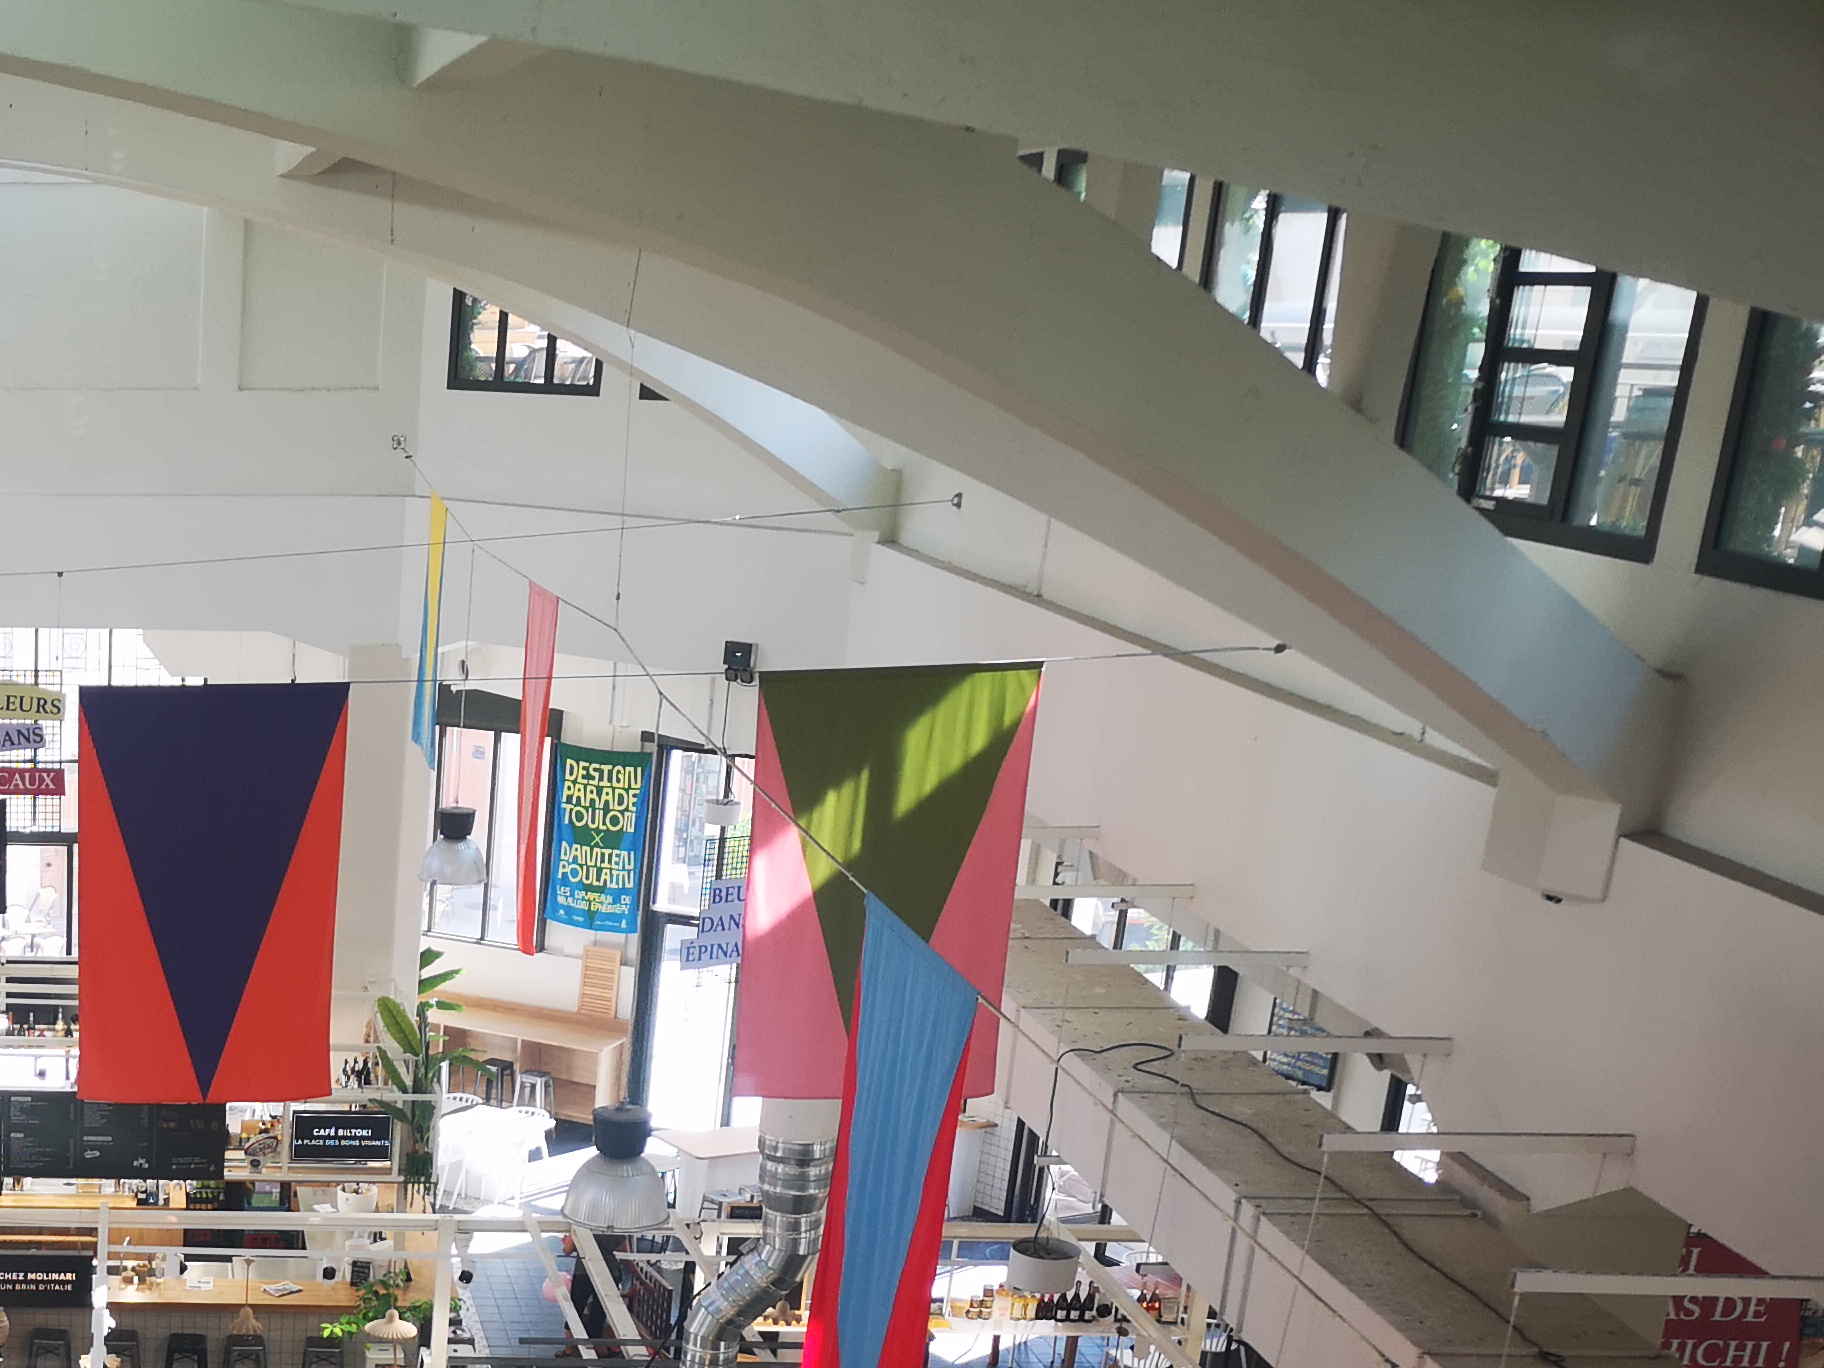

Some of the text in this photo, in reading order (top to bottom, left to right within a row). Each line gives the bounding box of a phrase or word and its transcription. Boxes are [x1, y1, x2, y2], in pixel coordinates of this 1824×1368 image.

[565, 758, 642, 788] DESIGN
[562, 781, 640, 812] PARADE
[561, 803, 636, 833] TOULON
[560, 841, 635, 870] DAMIEN
[557, 861, 634, 889] POULAIN
[700, 913, 744, 933] DAN
[685, 941, 742, 962] ÉPINA
[313, 1126, 335, 1136] CAFÉ
[27, 1272, 76, 1280] MOLINARI
[1710, 1296, 1770, 1322] DE
